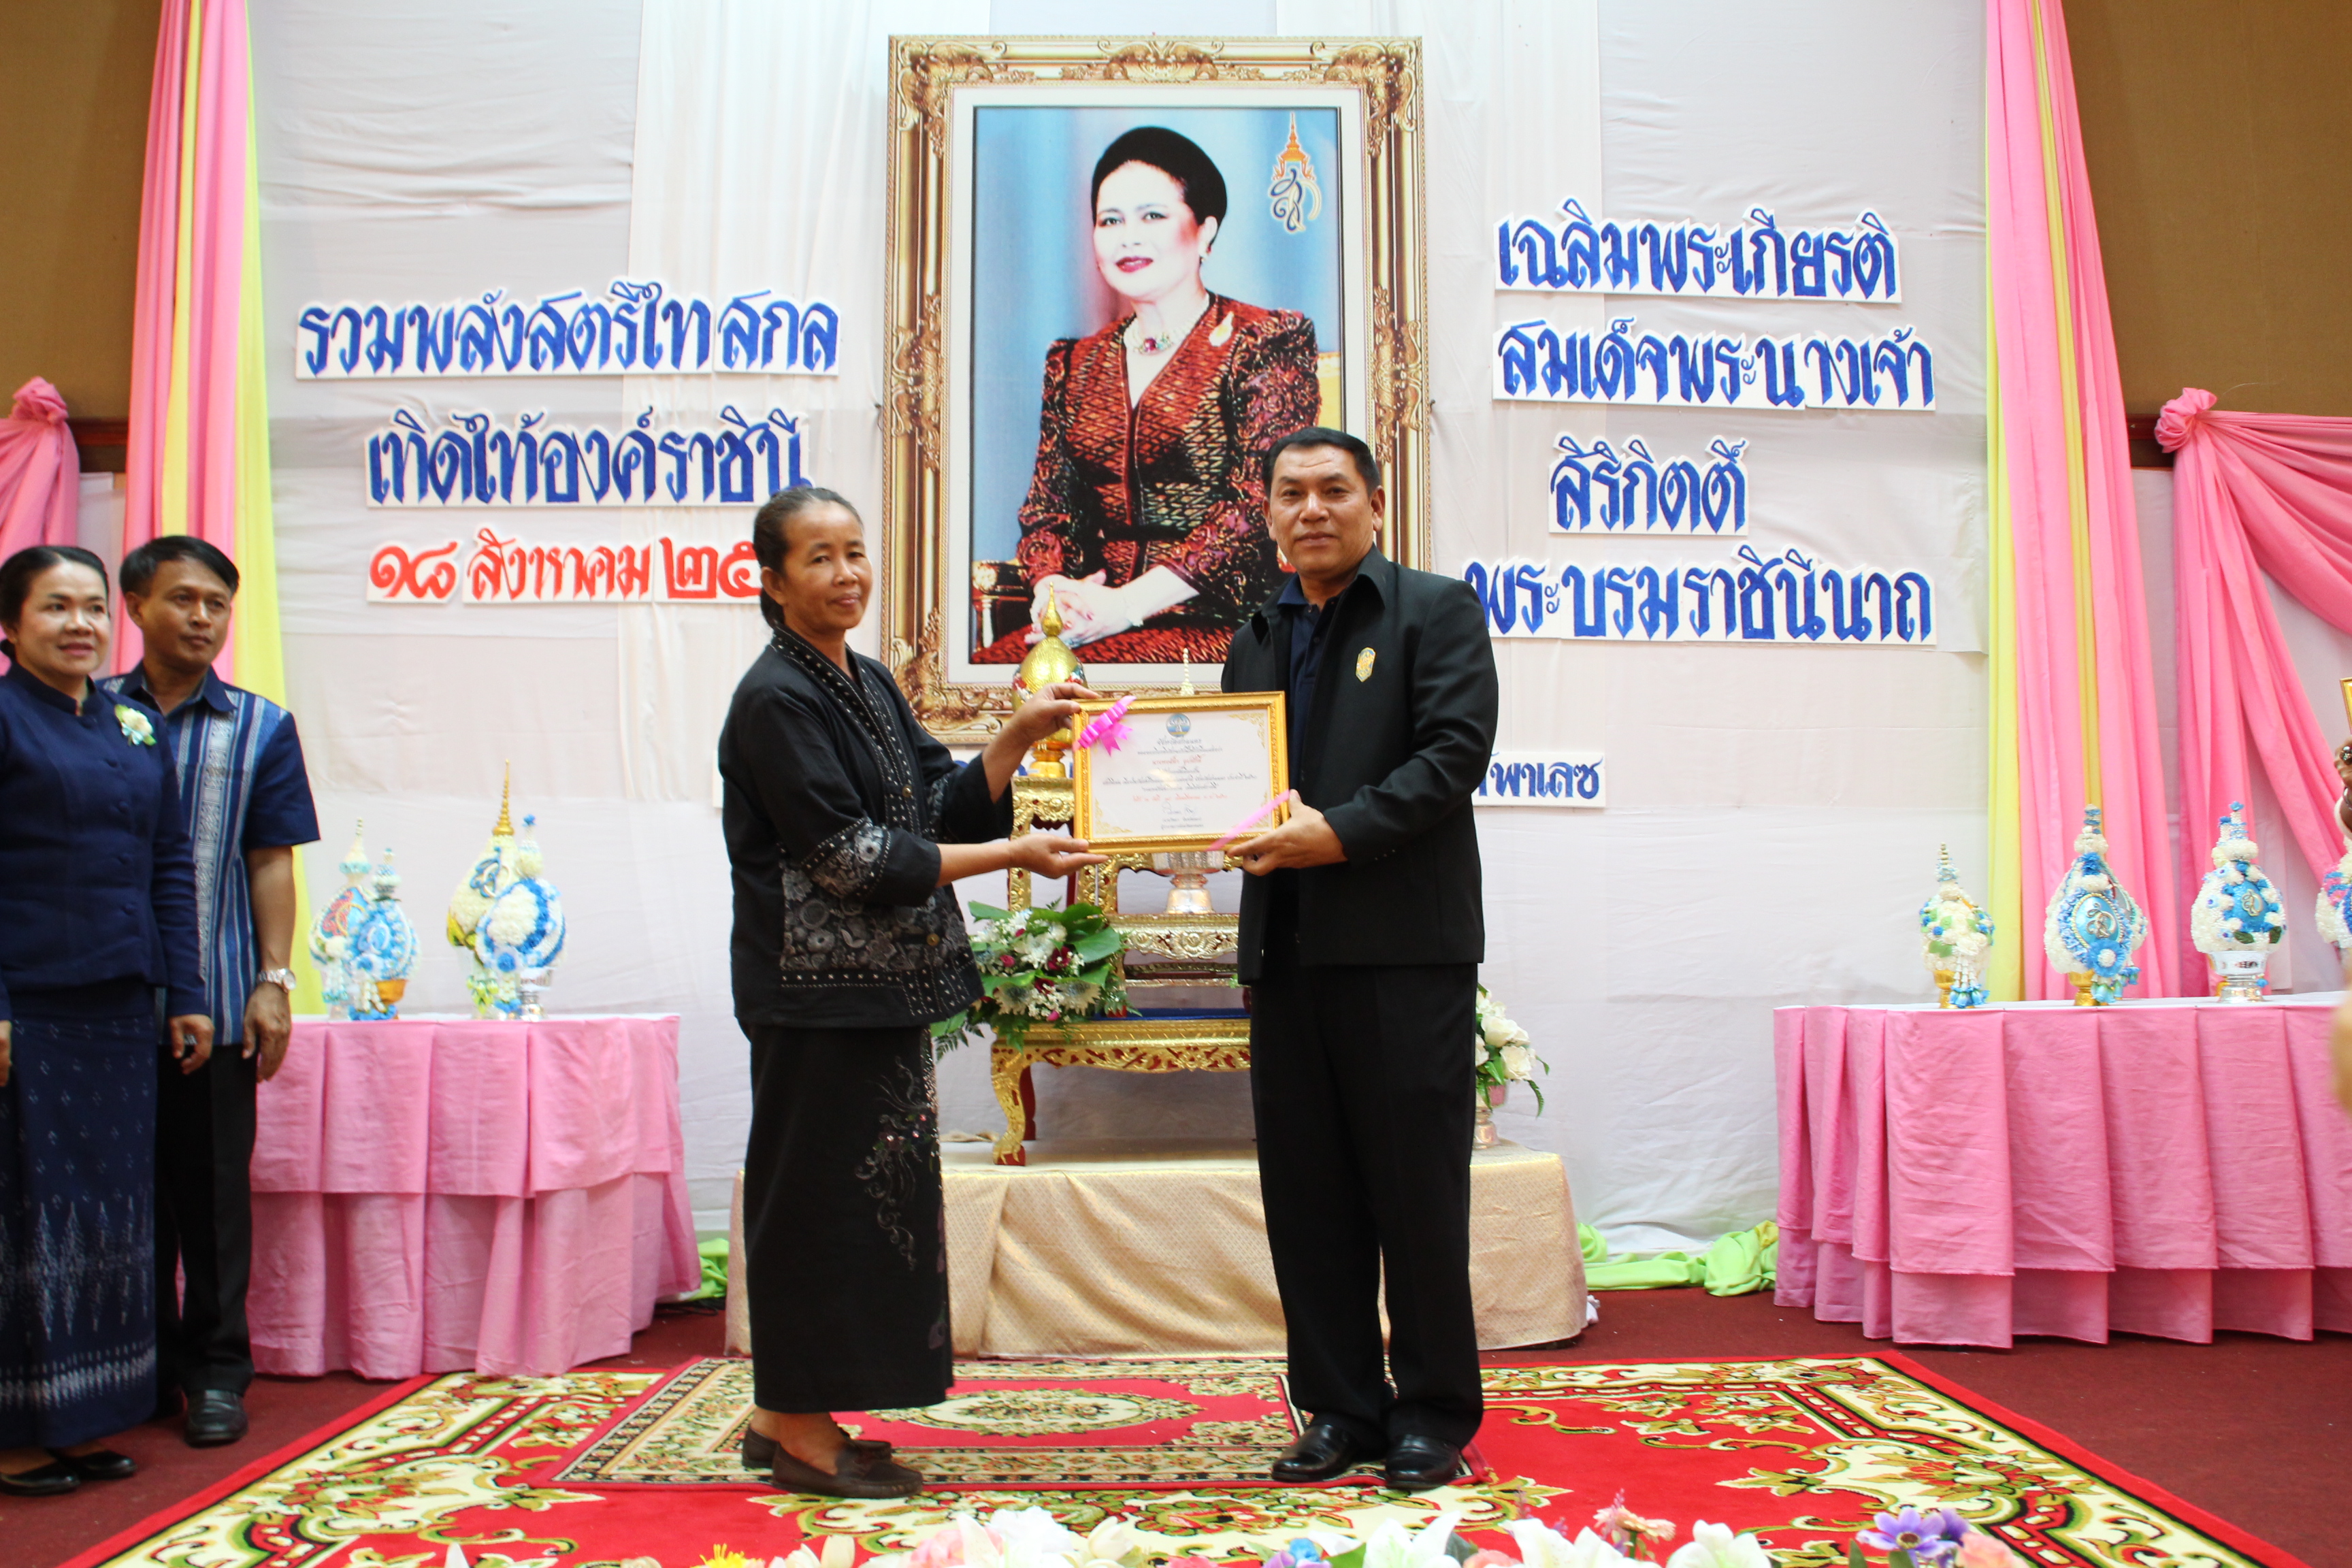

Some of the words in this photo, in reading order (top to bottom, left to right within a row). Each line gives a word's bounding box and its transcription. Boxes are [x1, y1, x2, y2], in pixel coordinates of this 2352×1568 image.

[1499, 197, 1897, 299] เฉลิมพระเกียรติ
[1498, 316, 1936, 408] สมเด็จพระนางเจ้า
[370, 541, 459, 600] ๑๘
[467, 527, 651, 601] สิงหาคม
[1465, 544, 1932, 642] พระบรมราชินีนาถ
[1479, 751, 1603, 800] พาเลซ
